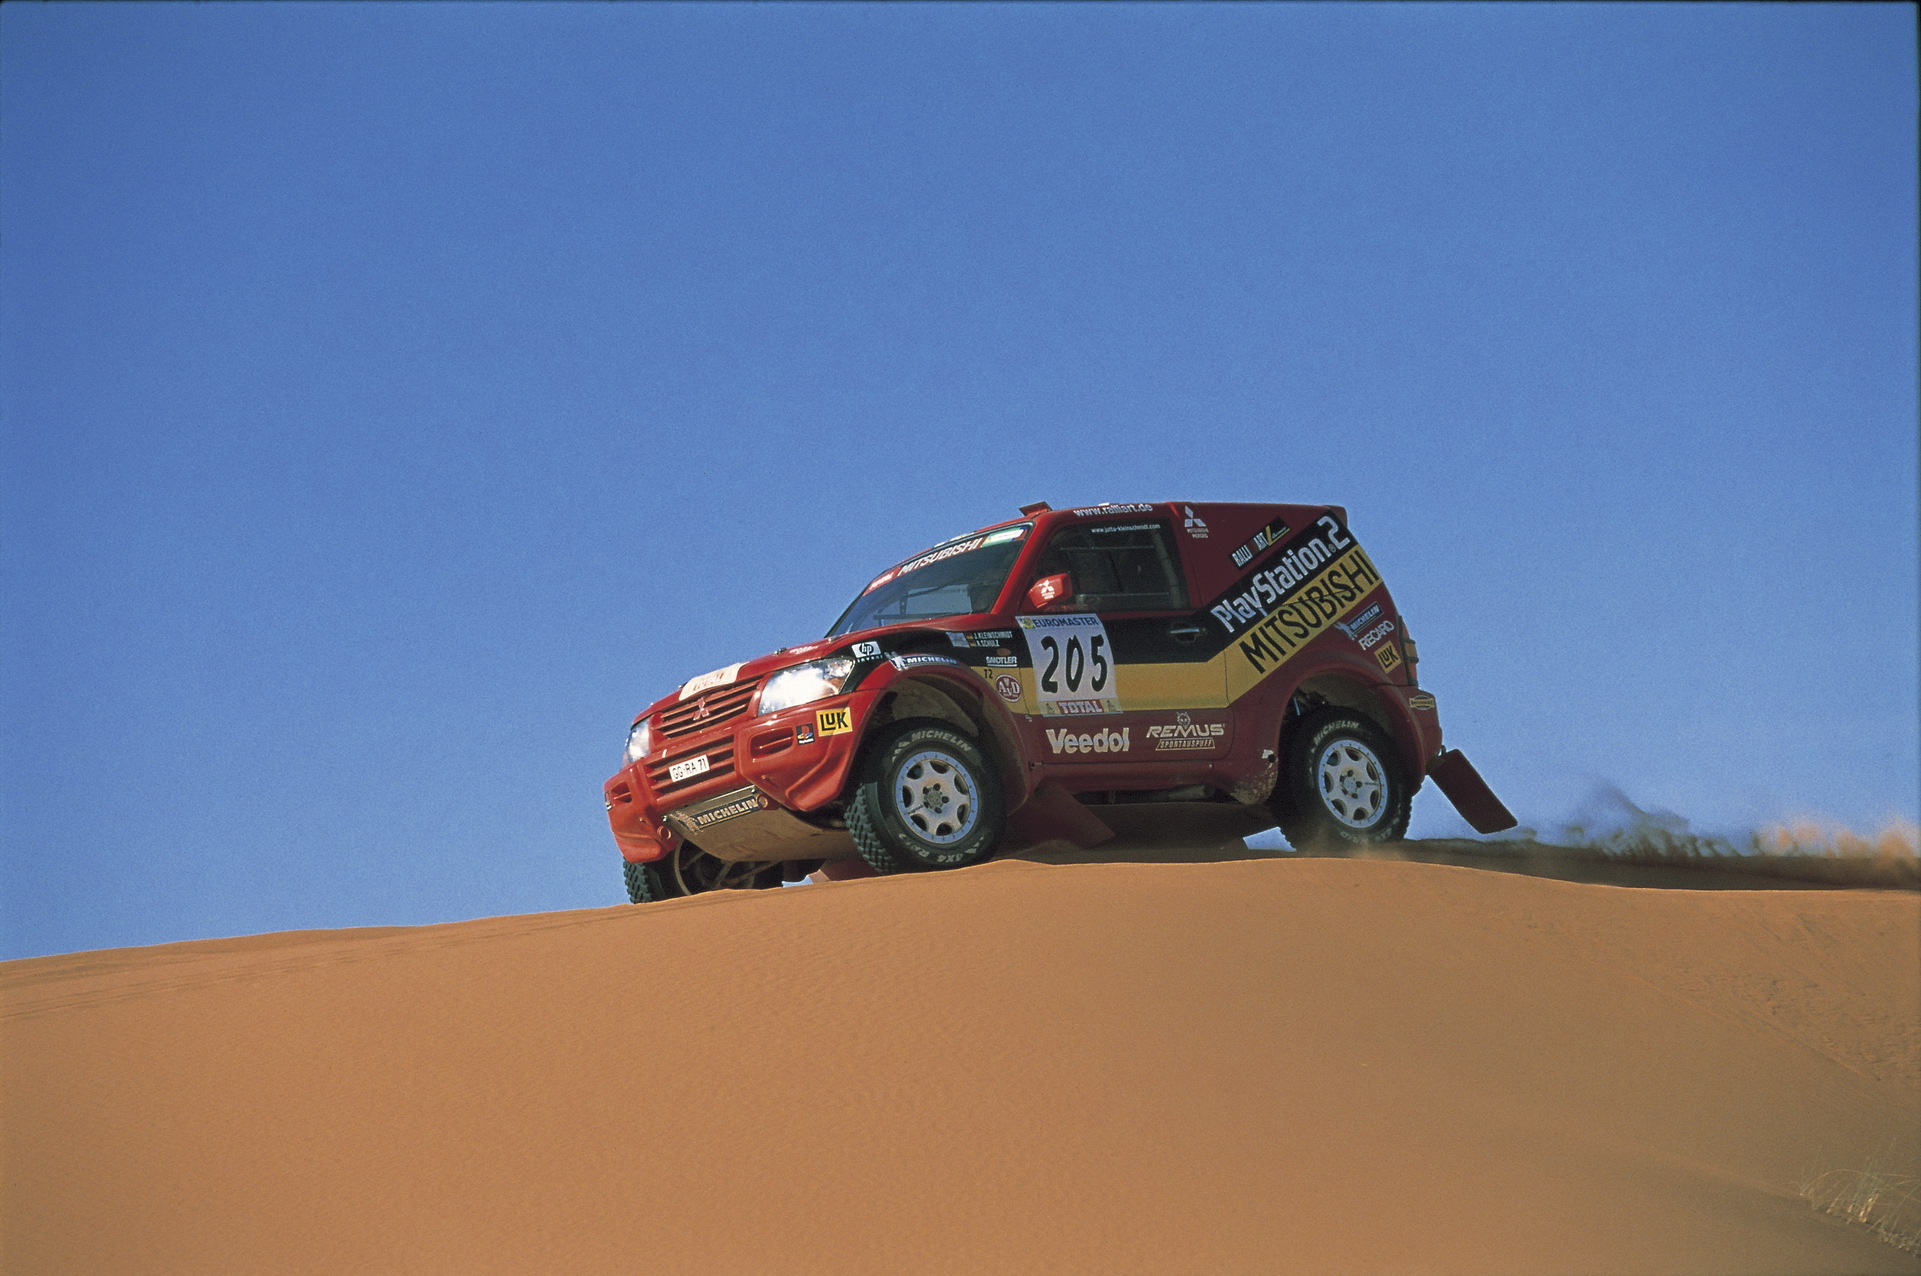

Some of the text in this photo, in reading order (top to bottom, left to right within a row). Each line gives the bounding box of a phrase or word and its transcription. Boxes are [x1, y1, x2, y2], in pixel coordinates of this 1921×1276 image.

[897, 537, 983, 576] MITSUBISHI
[1032, 617, 1099, 628] EUROMASTER
[1239, 550, 1380, 674] MITSUBISHI
[1359, 620, 1395, 651] RECARO
[1041, 634, 1108, 693] 205
[1058, 700, 1103, 714] TOTAL
[911, 730, 972, 752] MICHELIN
[1045, 727, 1130, 754] Veedol
[1146, 724, 1225, 739] REMUS
[697, 798, 759, 825] MICHELIN
